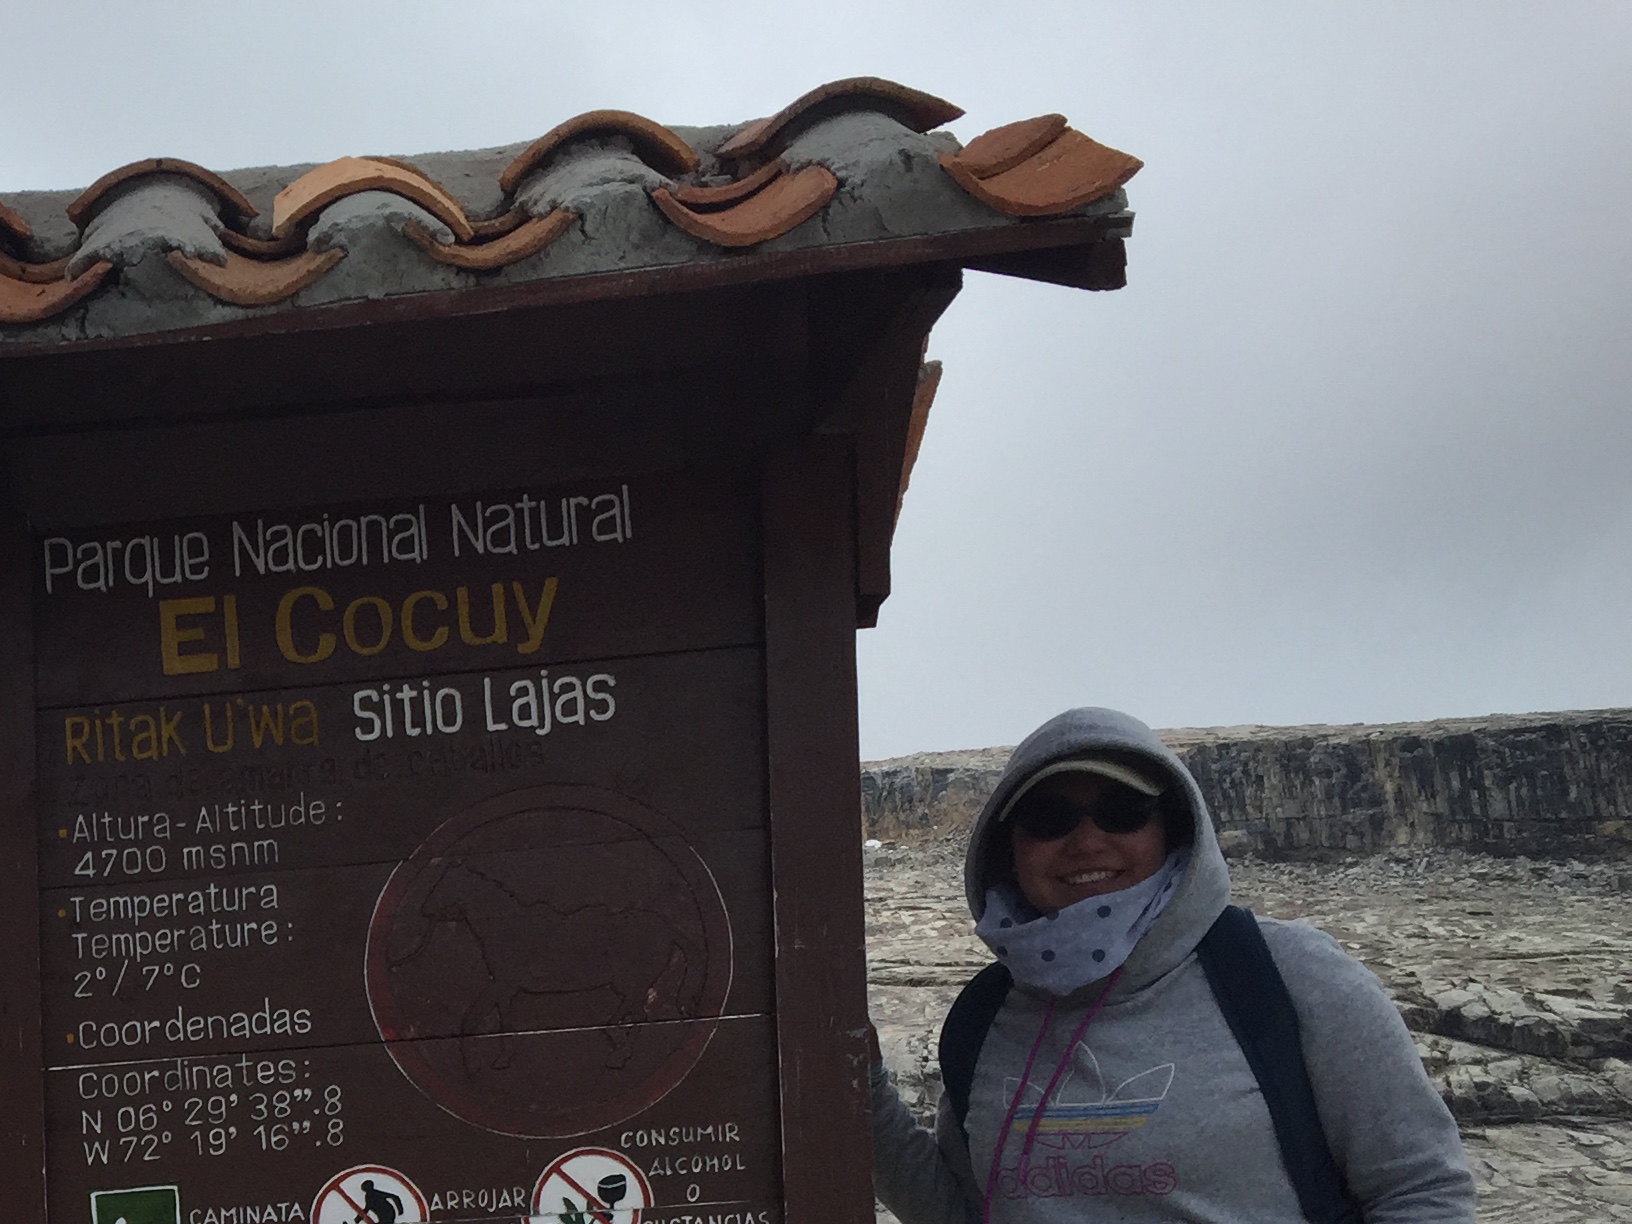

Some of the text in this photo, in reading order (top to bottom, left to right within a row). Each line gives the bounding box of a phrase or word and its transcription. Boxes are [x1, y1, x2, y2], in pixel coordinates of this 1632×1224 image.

[44, 484, 633, 597] Parque Nacional Natural
[159, 577, 559, 675] El Cocuy
[353, 671, 616, 741] Sitio Lajas
[66, 704, 187, 766] Ritak
[74, 839, 280, 878] 4700 msnm
[70, 883, 279, 926] Temperatura
[71, 919, 294, 962] Temperature:
[78, 997, 313, 1050] Coordenadas
[78, 1053, 311, 1100] Coordinates:
[81, 1110, 102, 1135] N
[620, 1122, 741, 1149] CONSUMIR
[83, 1140, 109, 1165] W
[996, 1154, 1177, 1200] adidas
[429, 1187, 526, 1214] ARROJAR
